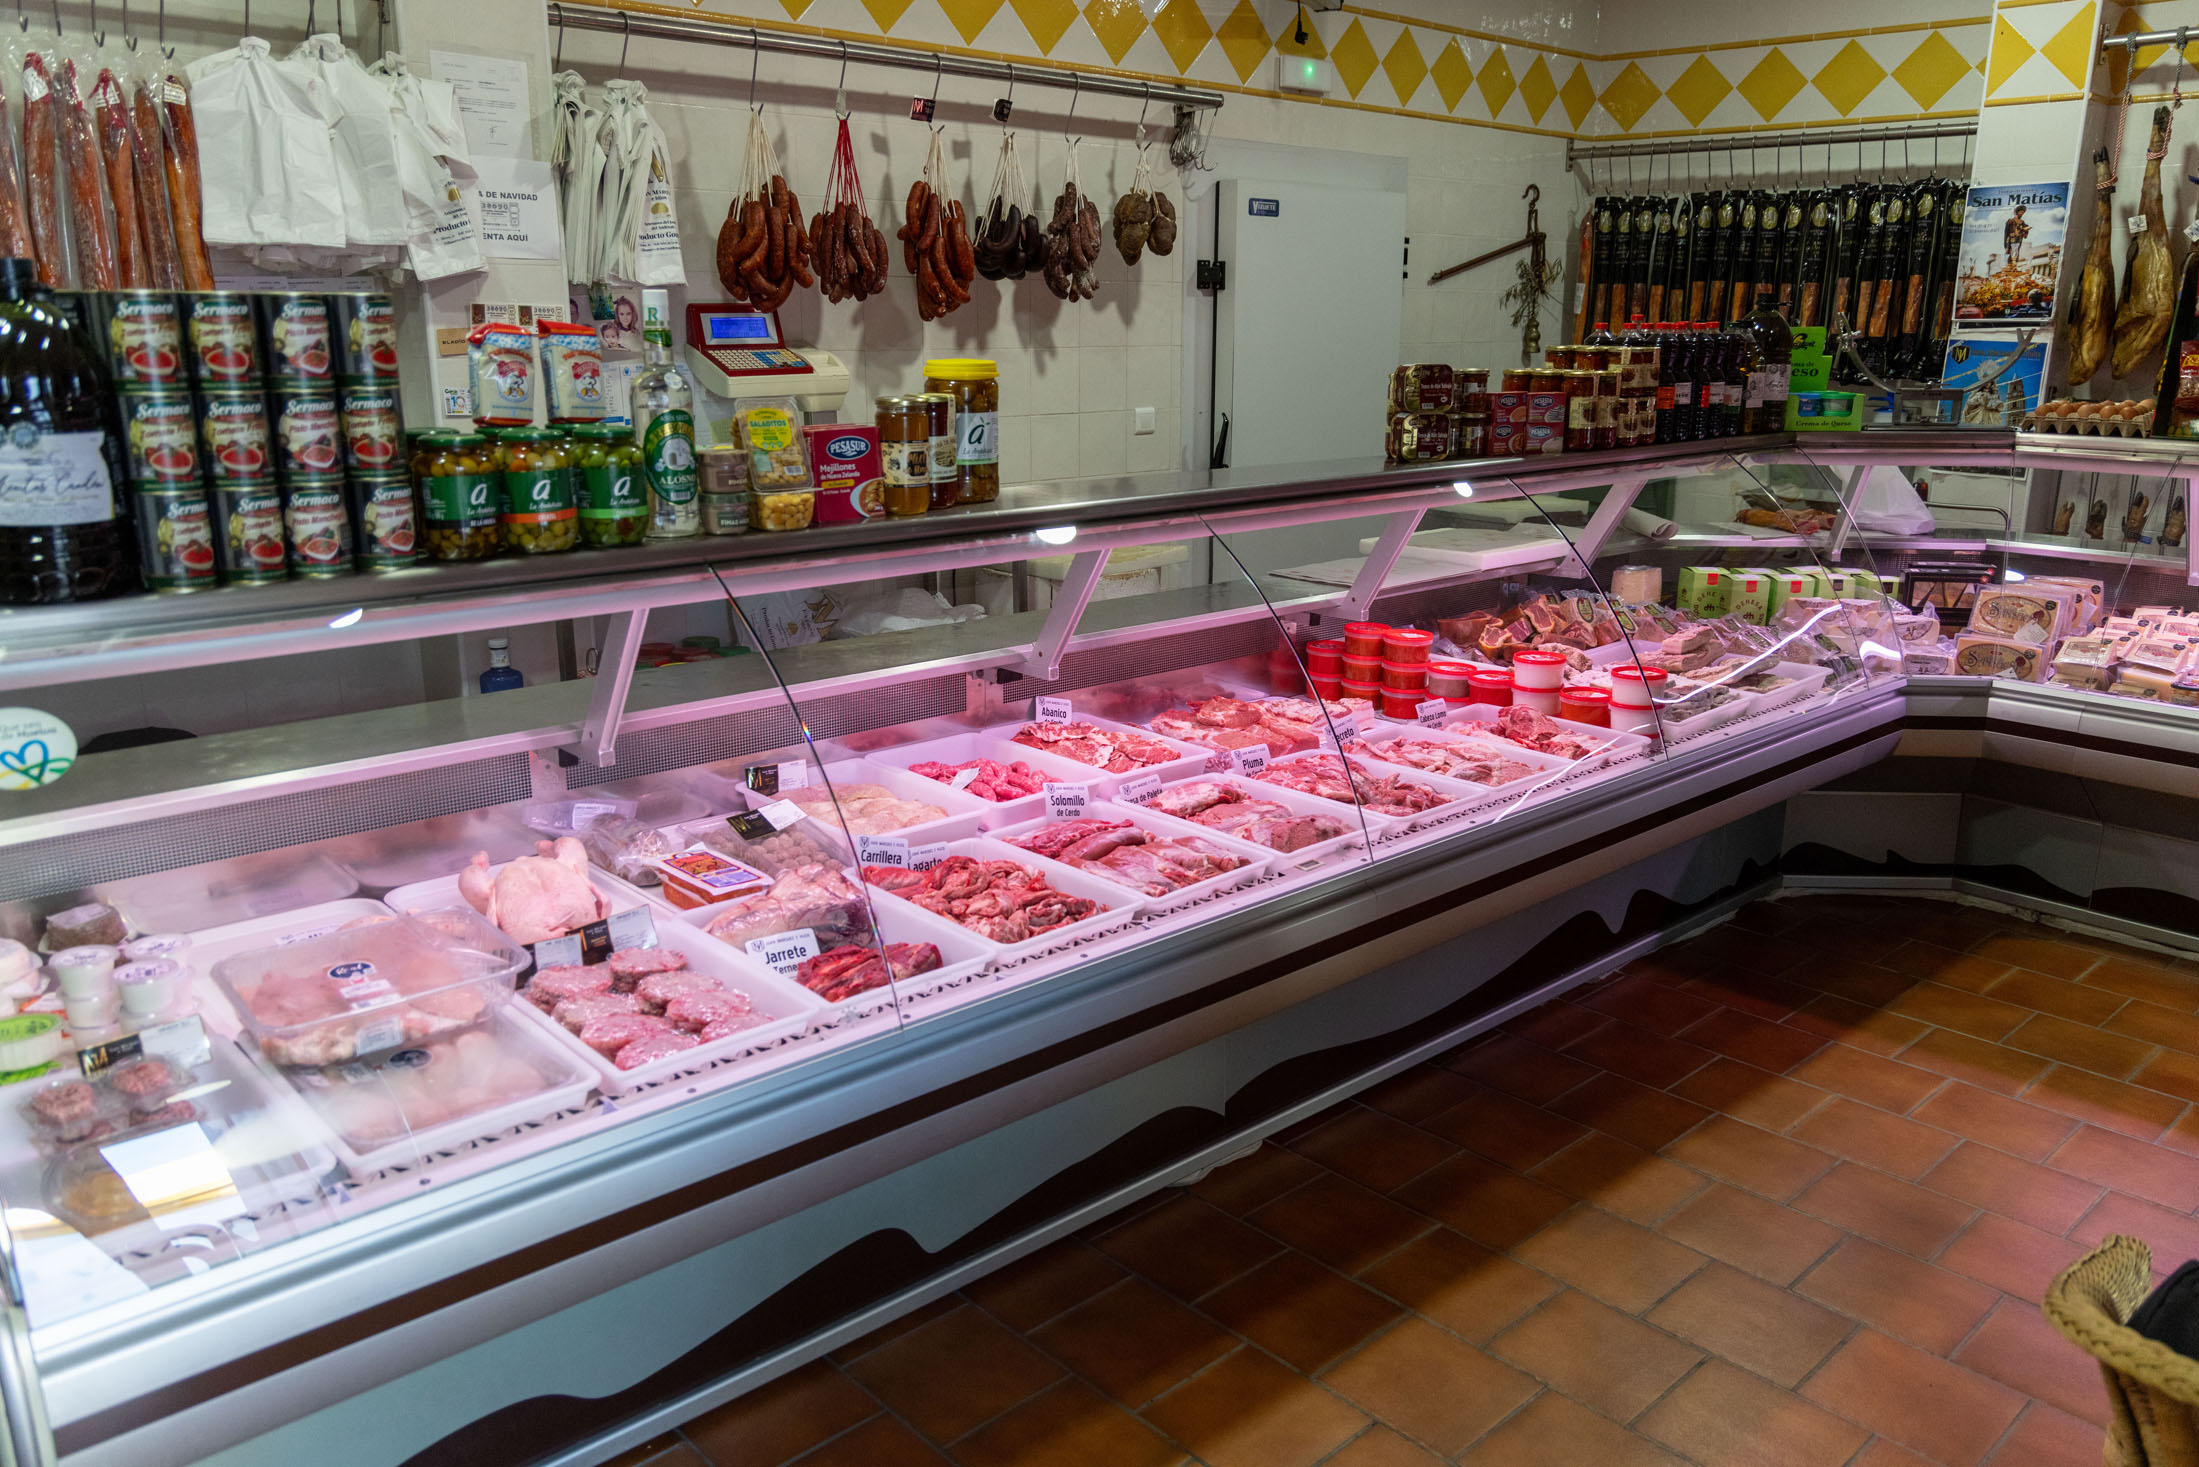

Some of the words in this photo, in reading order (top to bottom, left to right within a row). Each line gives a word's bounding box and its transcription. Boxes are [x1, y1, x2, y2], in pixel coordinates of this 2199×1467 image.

[486, 191, 498, 199] DE
[500, 192, 538, 201] NAVIDAD
[1972, 196, 2001, 207] San
[2008, 191, 2063, 205] Matías
[117, 300, 174, 318] Sermaco
[194, 302, 248, 318] Sermaco
[1791, 367, 1819, 377] eso
[137, 402, 190, 420] Sermaco
[209, 401, 261, 418] Sermaco
[287, 400, 335, 417] Sermaco
[344, 396, 393, 412] Sermaco
[750, 420, 786, 428] SALADITOS
[1831, 420, 1851, 428] Queso
[830, 440, 867, 454] PESASUR
[820, 463, 856, 476] Mejillones
[289, 493, 340, 509] Sermaco
[1736, 600, 1763, 610] DEHESA
[1041, 706, 1067, 719] Abanico
[1420, 713, 1435, 724] Cabeza
[1435, 710, 1447, 719] Lomo
[1242, 758, 1264, 770] Pluma
[1050, 794, 1085, 806] Solomillo
[1140, 794, 1147, 802] de
[1146, 788, 1163, 799] Paleta
[1056, 808, 1064, 816] de
[1065, 808, 1080, 816] Cerdo
[861, 849, 902, 865] Carrillera
[765, 945, 807, 965] Jarrete
